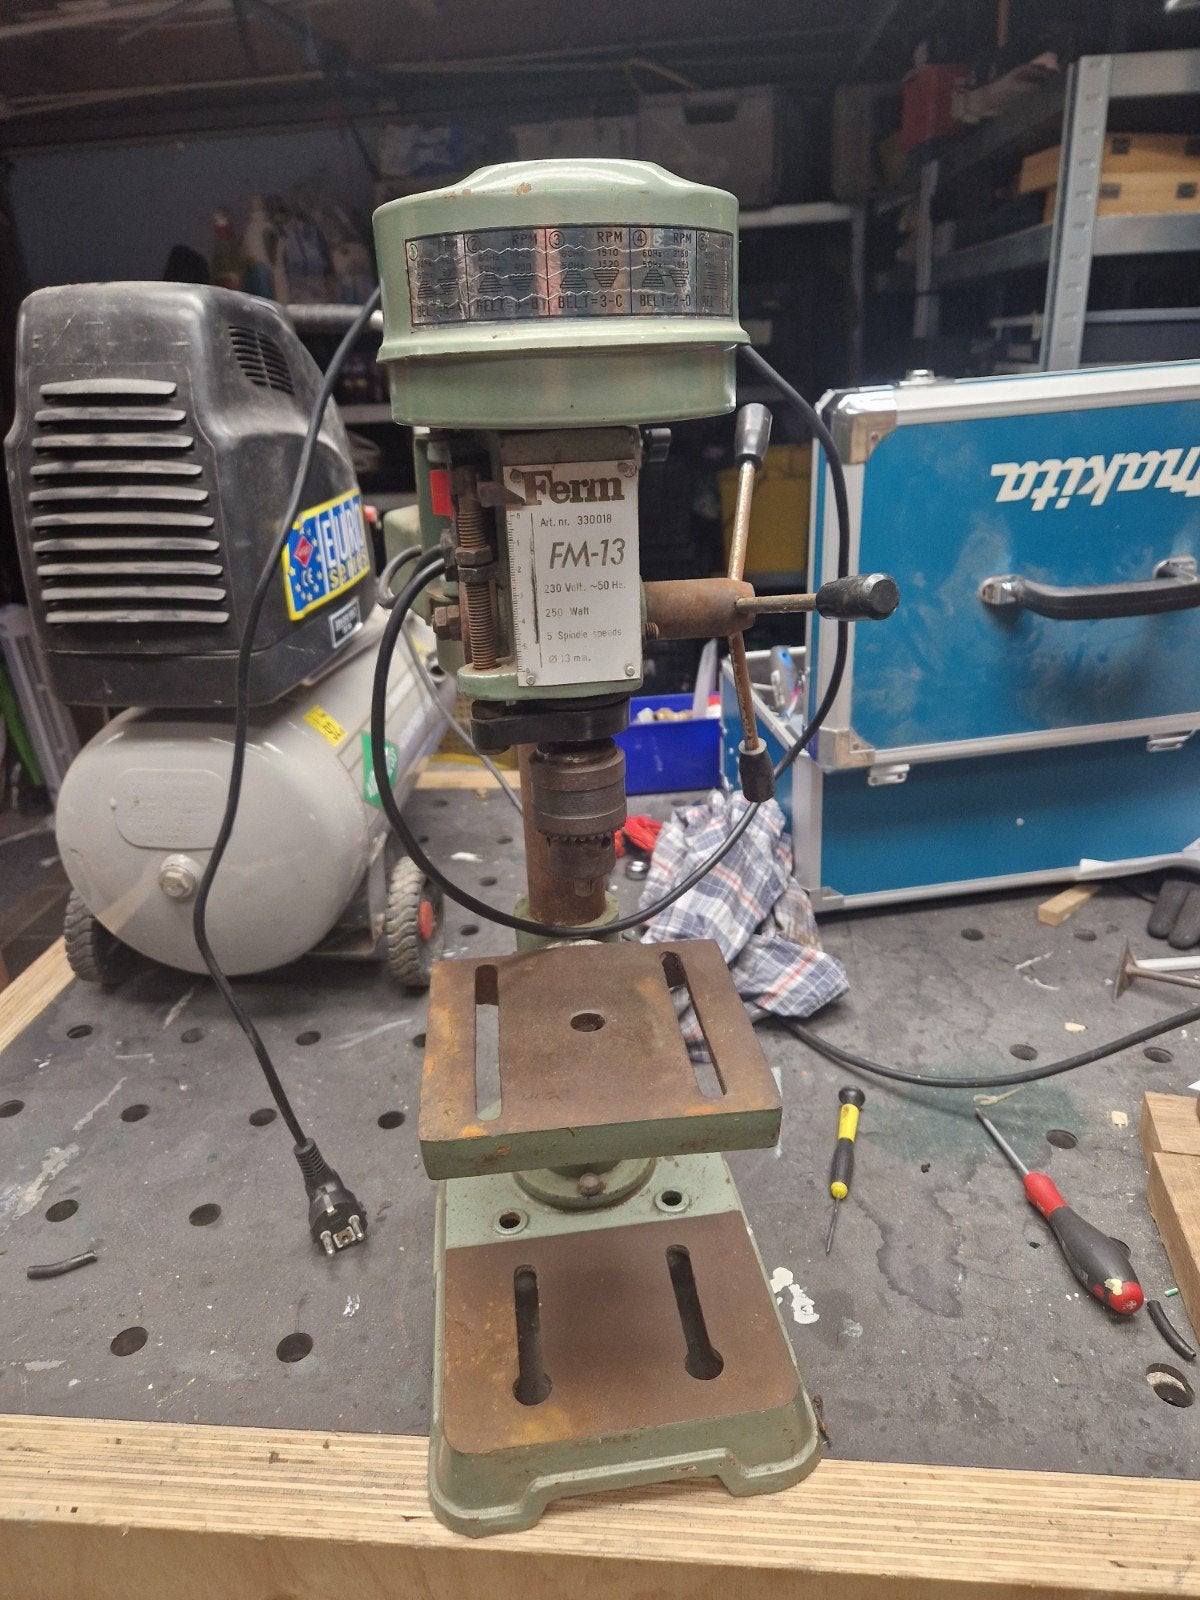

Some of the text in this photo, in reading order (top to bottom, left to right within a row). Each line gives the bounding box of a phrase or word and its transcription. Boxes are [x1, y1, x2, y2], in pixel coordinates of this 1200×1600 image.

[597, 231, 623, 243] RPM
[673, 232, 692, 244] RPM
[642, 249, 662, 258] 60Hz
[519, 469, 626, 506] Ferm
[540, 513, 612, 528] Art. nr. 330018
[549, 537, 626, 570] FM-13
[544, 584, 562, 594] 230
[545, 606, 590, 618] 250 Watt
[546, 628, 622, 643] 5 Spindle speds
